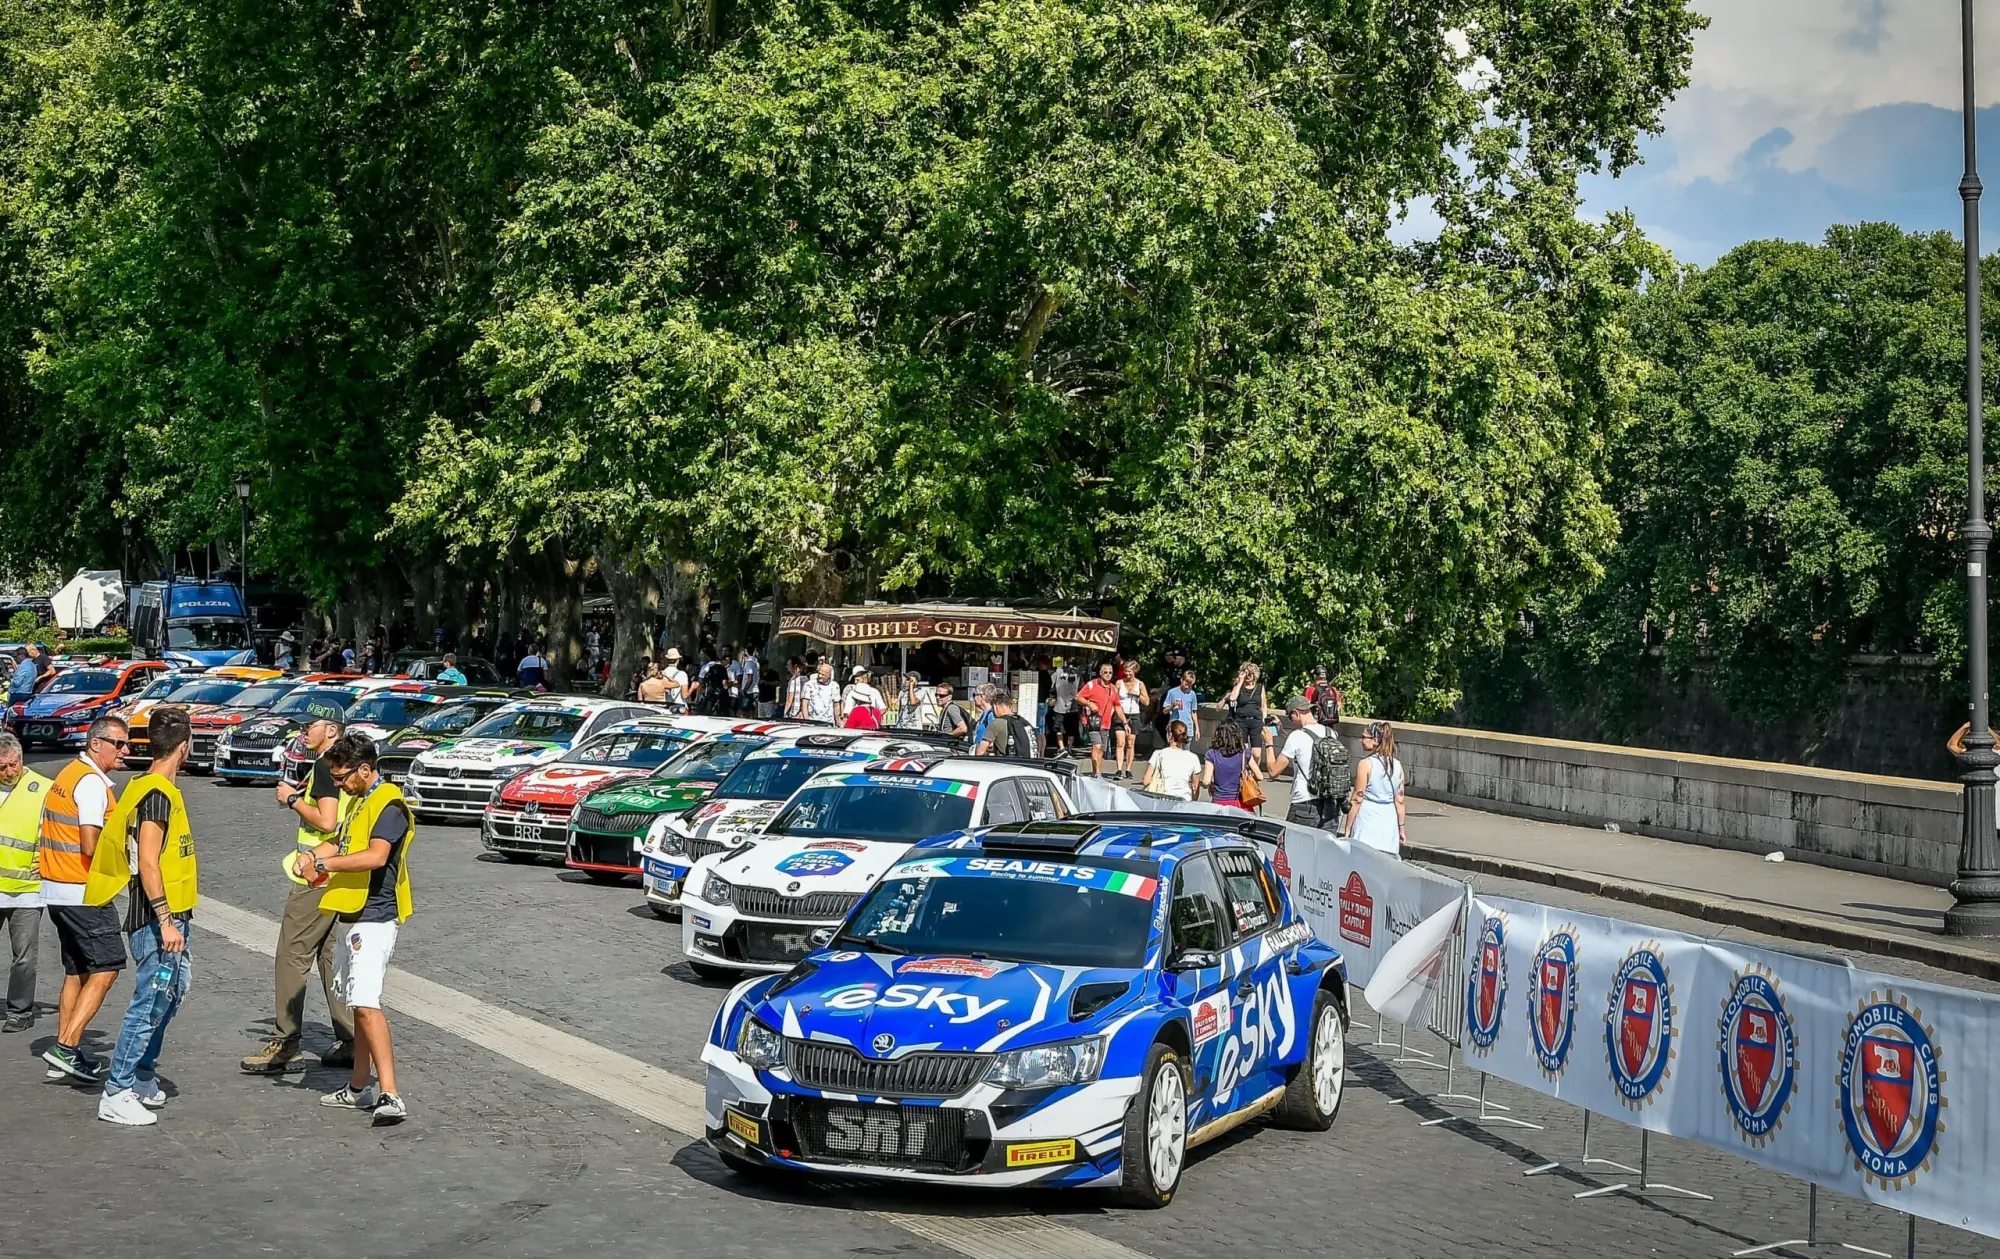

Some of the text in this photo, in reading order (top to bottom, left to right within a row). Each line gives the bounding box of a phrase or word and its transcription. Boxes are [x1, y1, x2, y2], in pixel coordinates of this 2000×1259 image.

[842, 620, 920, 638] BIBITE
[1036, 626, 1115, 644] DRINKS
[22, 722, 54, 736] i20
[868, 775, 933, 785] SEAJETS
[514, 825, 542, 840] BRR
[785, 863, 832, 872] 247
[786, 856, 845, 867] Finance
[803, 852, 839, 860] Car
[966, 858, 1096, 880] SEAJETS
[990, 871, 1016, 879] Racing
[1607, 952, 1653, 1025] AUTOMOBILE
[824, 984, 1010, 1024] eSky
[1660, 982, 1669, 1035] CLUB
[1721, 977, 1766, 1053] AUTOMOBILE
[1473, 1027, 1492, 1045] ROMA
[1778, 1011, 1793, 1068] CLUB
[1841, 1006, 1904, 1088] AUTOMOBILE
[1540, 1050, 1560, 1069] ROMA
[1742, 1054, 1761, 1095] SPQR
[1921, 1043, 1937, 1104] CLUB
[1618, 1076, 1646, 1096] ROMA
[1737, 1109, 1767, 1132] ROMA
[1871, 1090, 1898, 1134] SPQR
[729, 1114, 757, 1141] PIRELLI
[1011, 1144, 1071, 1162] PIRELLI
[1862, 1148, 1907, 1174] ROMA
